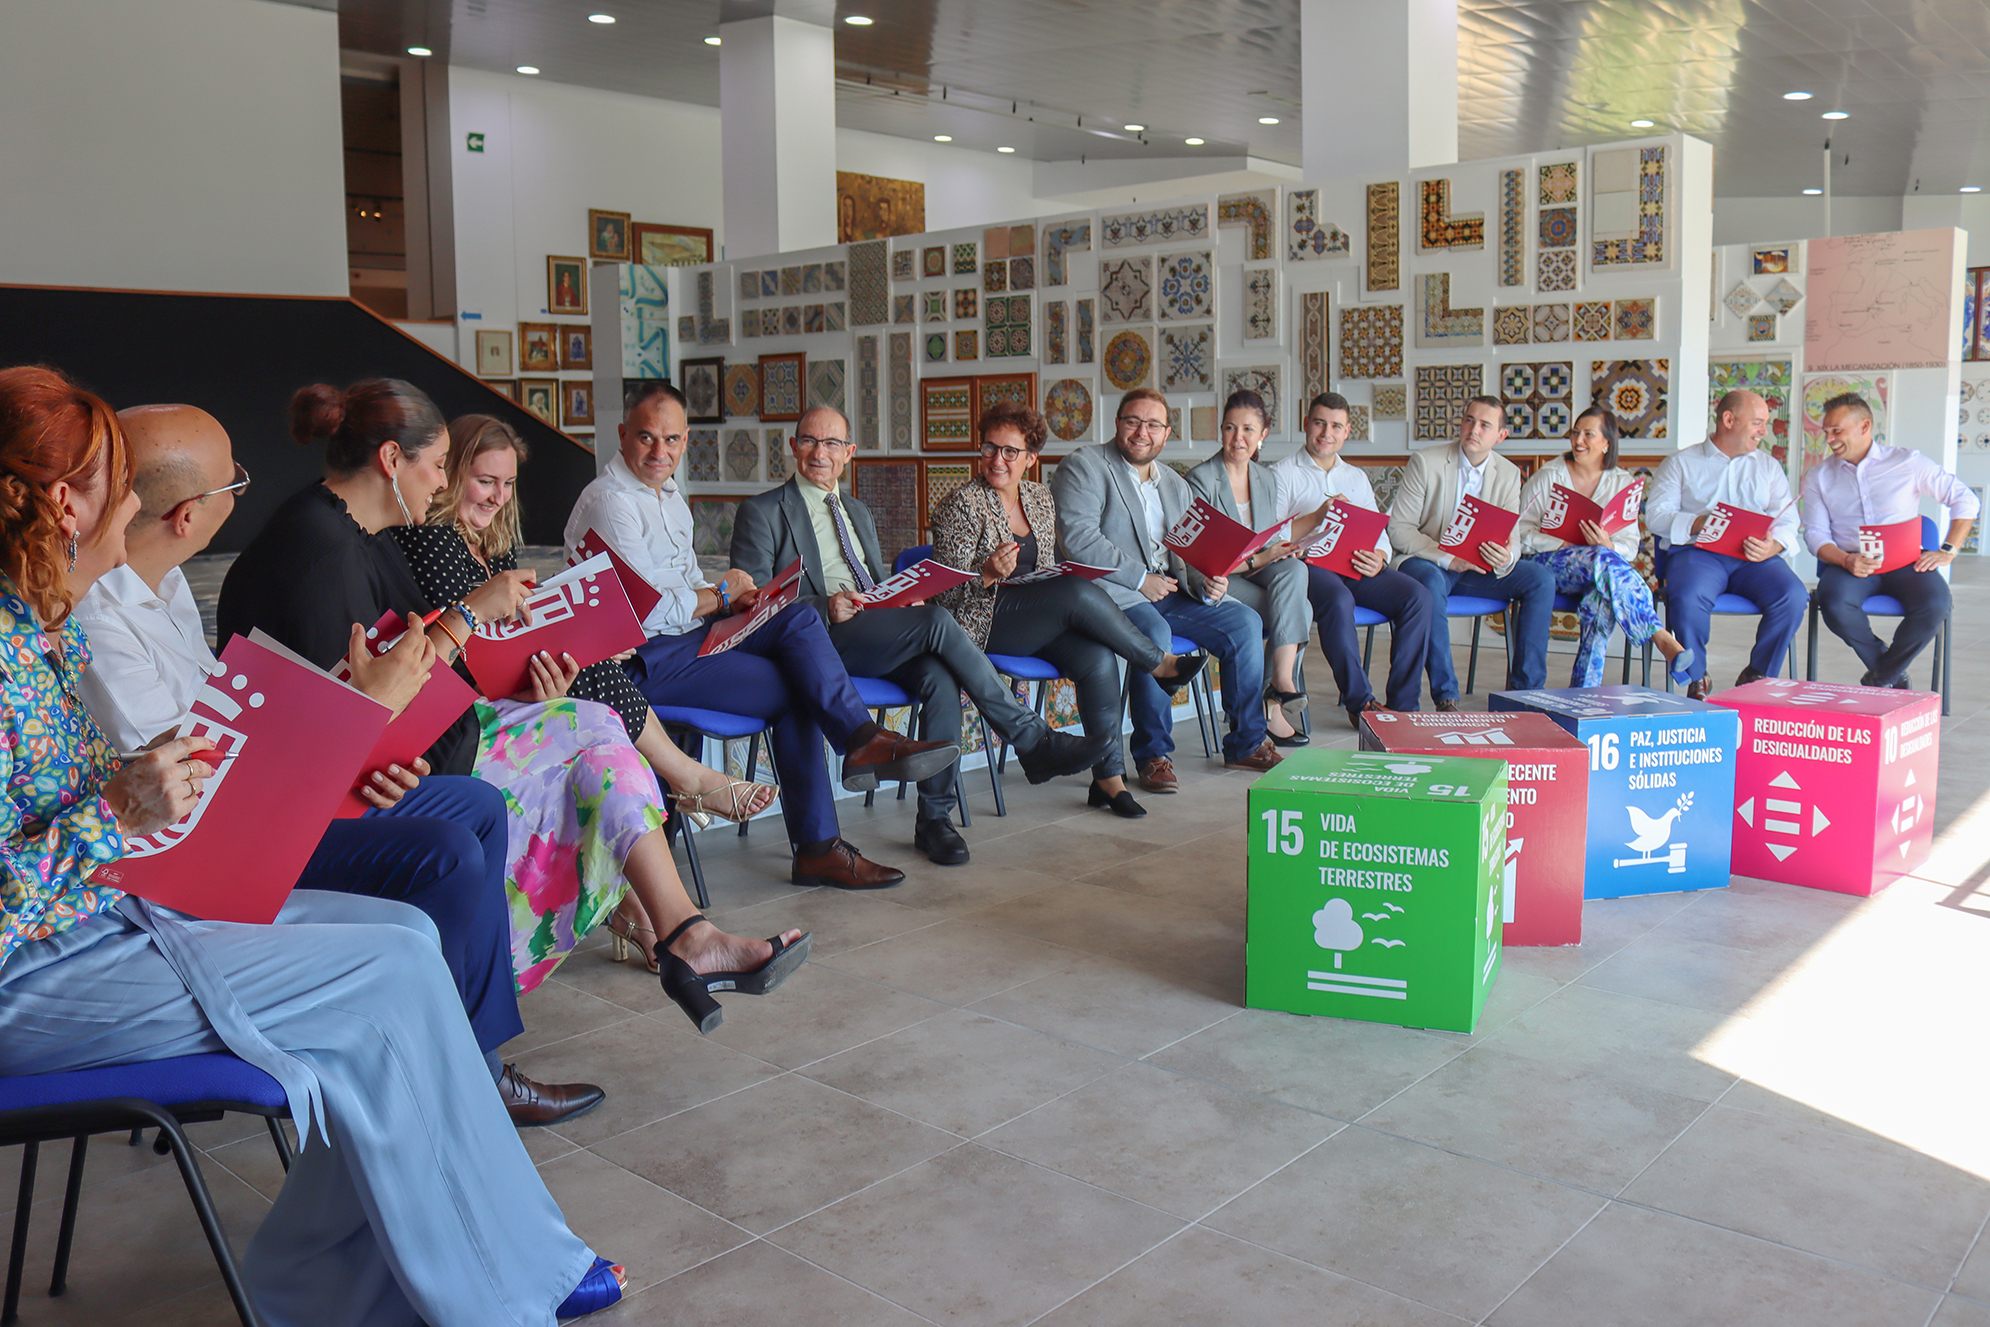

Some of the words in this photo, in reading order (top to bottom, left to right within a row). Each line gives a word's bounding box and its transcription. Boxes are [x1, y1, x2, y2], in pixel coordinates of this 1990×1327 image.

[1842, 361, 1900, 370] MECANIZACIÓN
[1902, 361, 1946, 369] (1850-1930)
[1376, 713, 1398, 722] 8
[1630, 730, 1655, 748] PAZ,
[1657, 727, 1706, 746] JUSTICIA
[1754, 717, 1825, 740] REDUCCIÓN
[1827, 726, 1845, 742] DE
[1847, 728, 1872, 745] LAS
[1587, 732, 1620, 771] 16
[1753, 738, 1853, 764] DESIGUALDADES
[1884, 725, 1898, 765] 10
[1629, 753, 1637, 769] E
[1639, 747, 1723, 768] INSTITUCIONES
[1289, 774, 1394, 787] ECOSISTEMAS
[1328, 771, 1418, 782] TERRESTRES
[1508, 764, 1557, 781] ECENTE
[1628, 770, 1677, 790] SÓLIDAS
[1374, 786, 1409, 794] VIDA
[1427, 784, 1471, 797] 15
[1261, 808, 1304, 856] 15
[1320, 812, 1357, 834] VIDA
[1319, 839, 1339, 860] DE
[1343, 841, 1450, 868] ECOSISTEMAS
[1318, 866, 1413, 893] TERRESTRES
